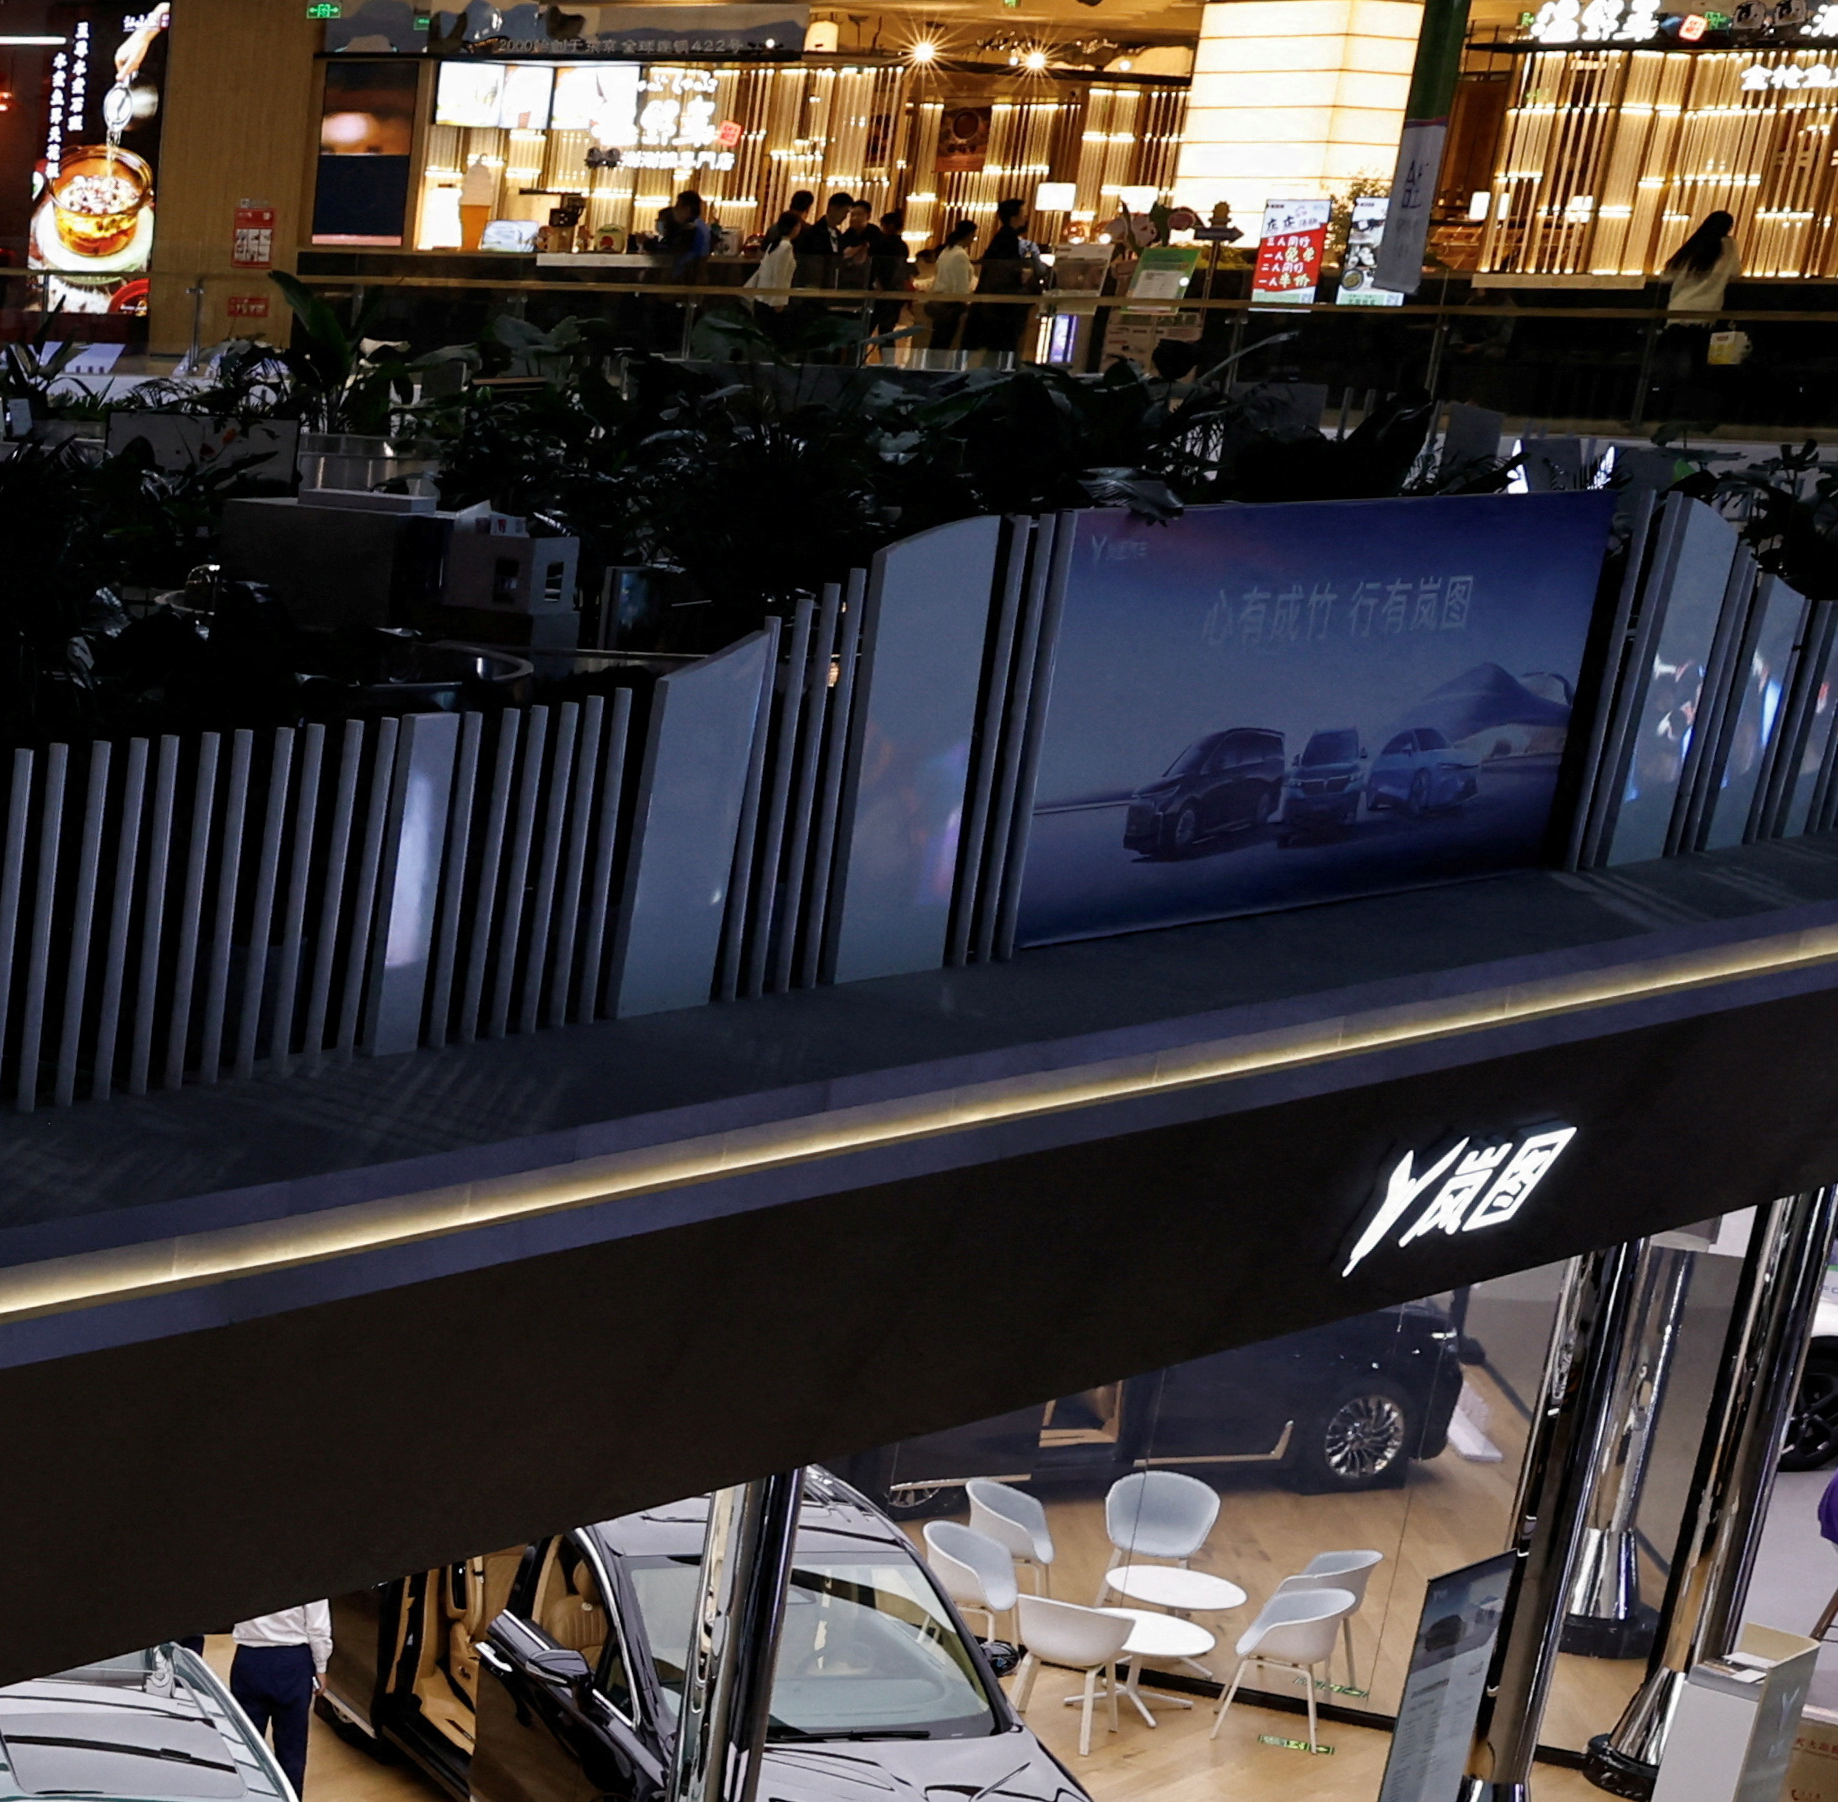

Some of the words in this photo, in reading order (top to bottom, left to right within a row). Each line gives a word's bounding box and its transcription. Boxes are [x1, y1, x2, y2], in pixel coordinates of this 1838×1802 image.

[1205, 586, 1338, 648] 心有成竹
[1348, 574, 1475, 640] 行有岚图
[1398, 1126, 1578, 1249] 岚图
